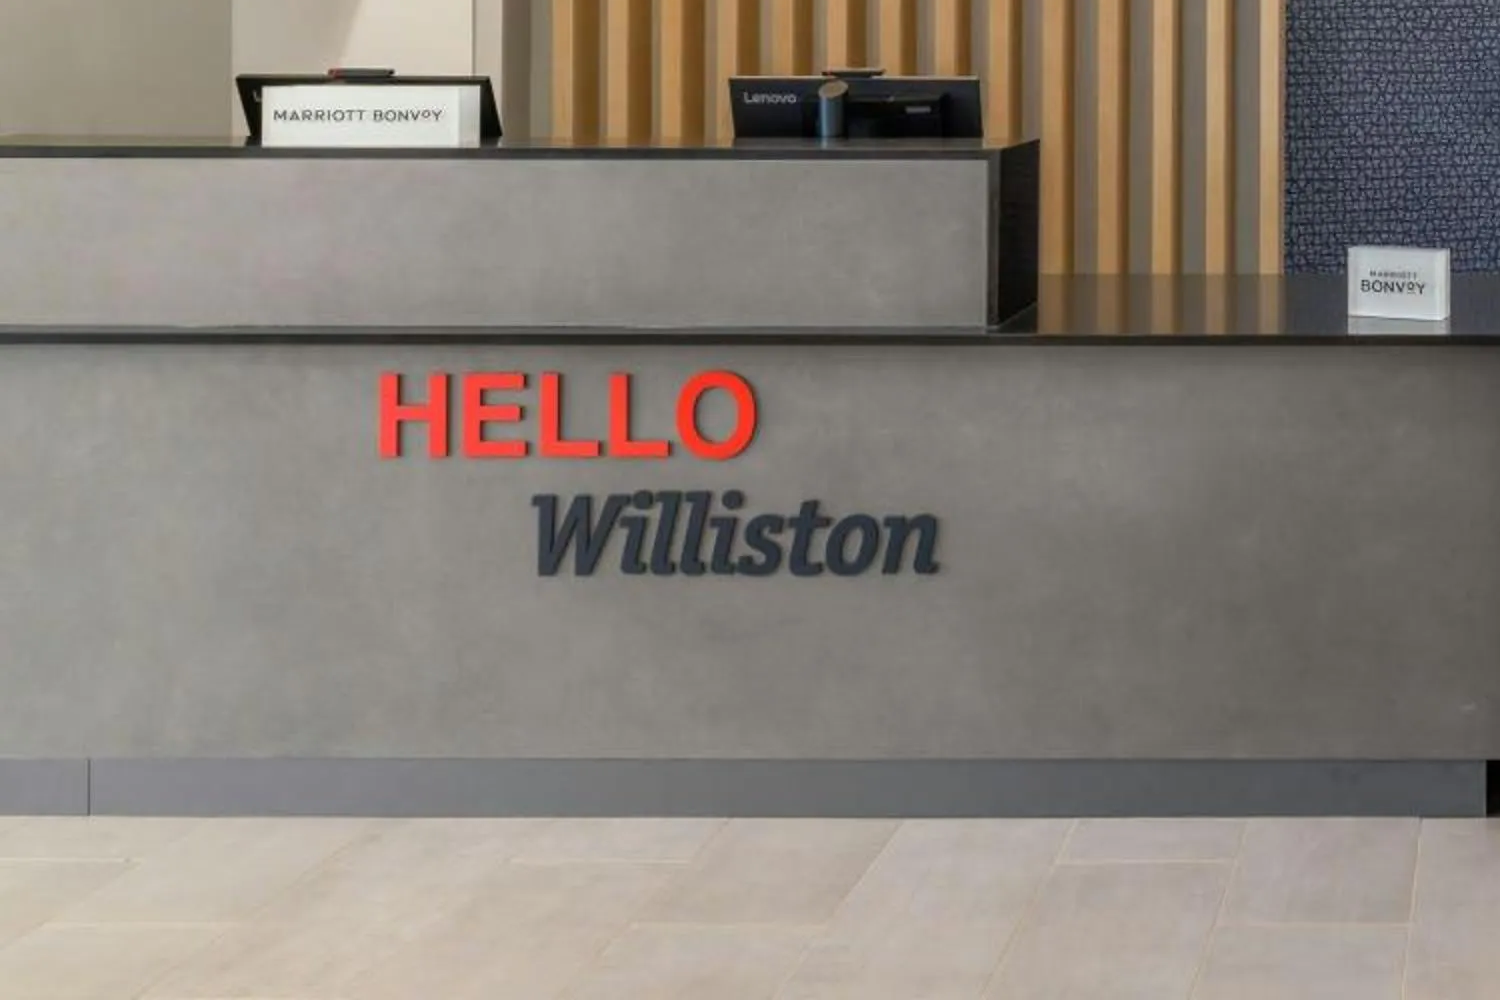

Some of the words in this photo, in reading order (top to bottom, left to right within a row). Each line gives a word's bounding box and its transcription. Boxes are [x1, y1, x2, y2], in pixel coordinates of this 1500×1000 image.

[743, 91, 797, 105] Lenovo
[273, 109, 364, 122] MARRIOTT
[373, 109, 443, 122] BONVOY
[1360, 280, 1425, 295] BONVOY
[379, 369, 758, 461] HELLO
[530, 488, 941, 577] Williston
